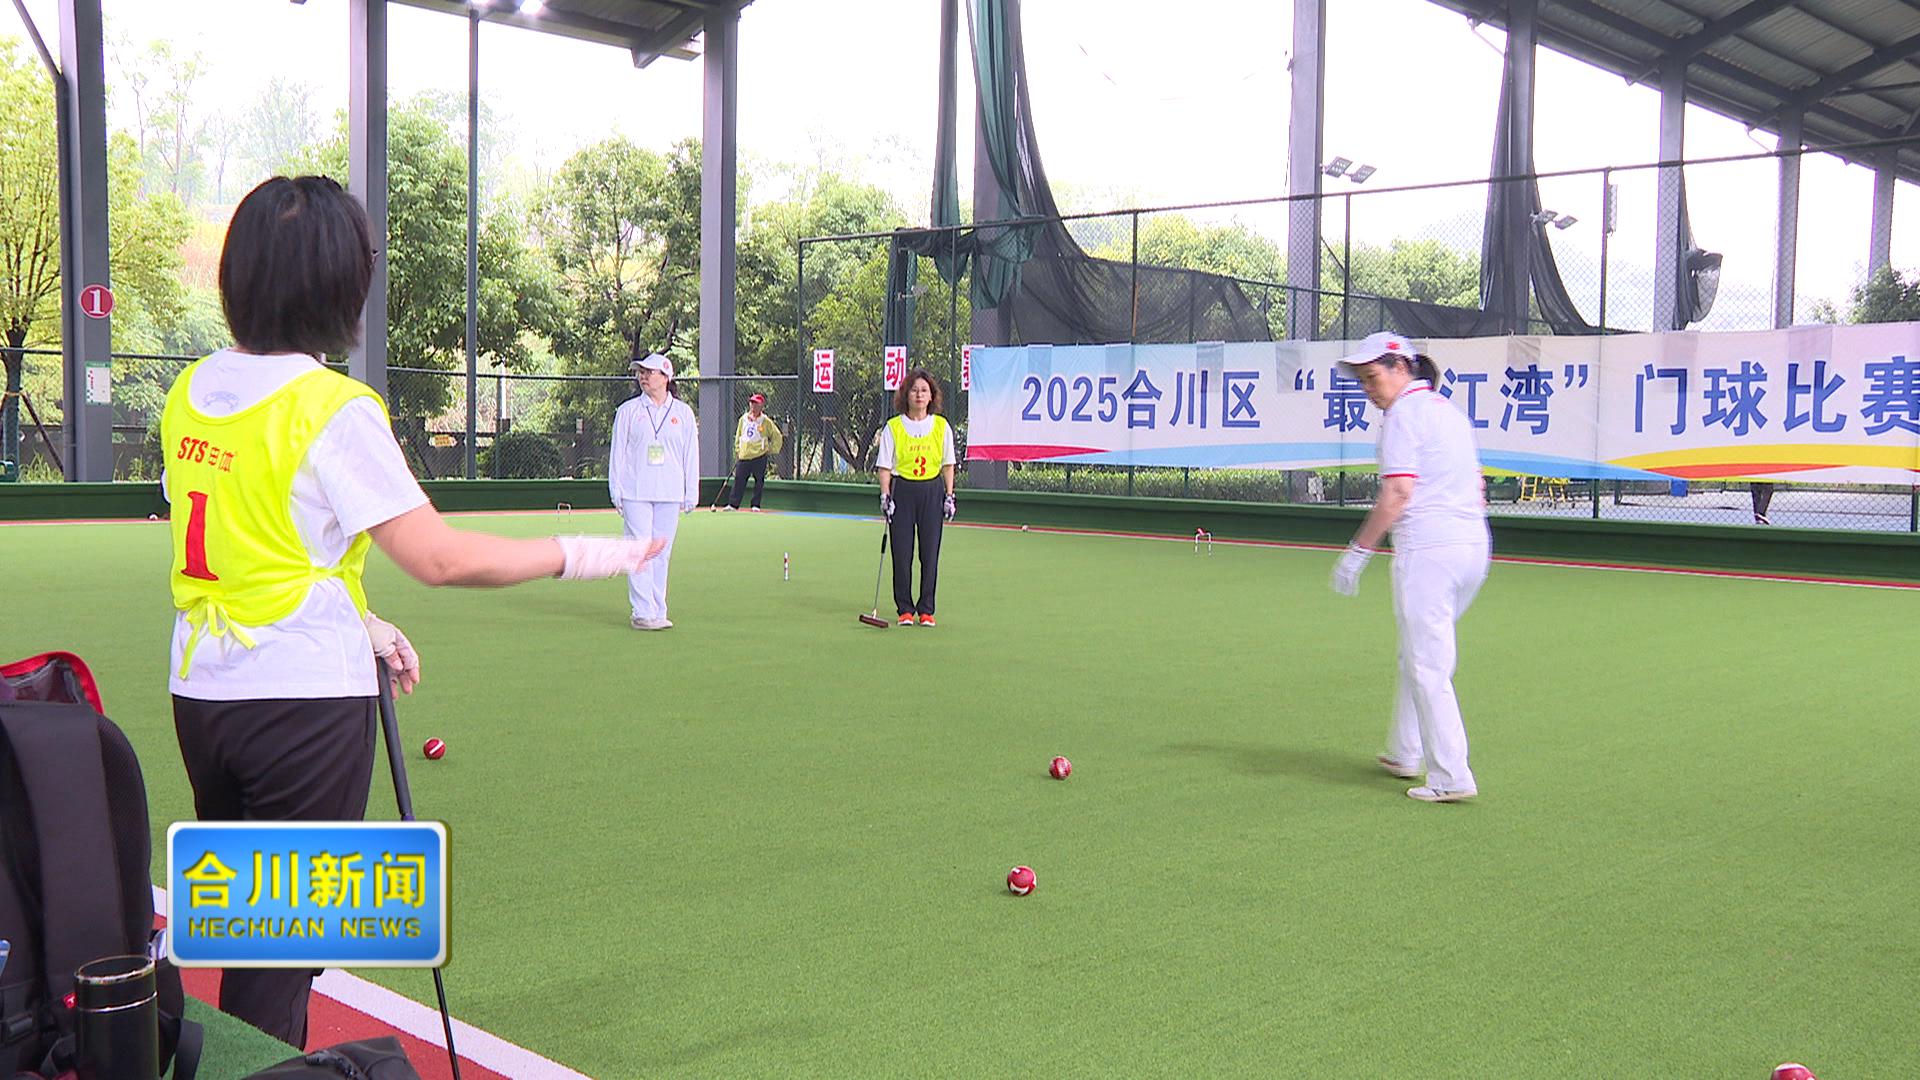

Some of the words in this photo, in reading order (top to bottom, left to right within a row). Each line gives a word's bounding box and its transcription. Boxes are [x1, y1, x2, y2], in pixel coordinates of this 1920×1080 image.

[89, 289, 105, 315] 1
[815, 353, 831, 390] 运
[886, 349, 905, 388] 动
[1021, 368, 1261, 430] 2025合川区
[1295, 363, 1589, 435] “最江湾”
[177, 436, 209, 463] STS
[913, 456, 927, 477] 3
[180, 491, 220, 581] 1
